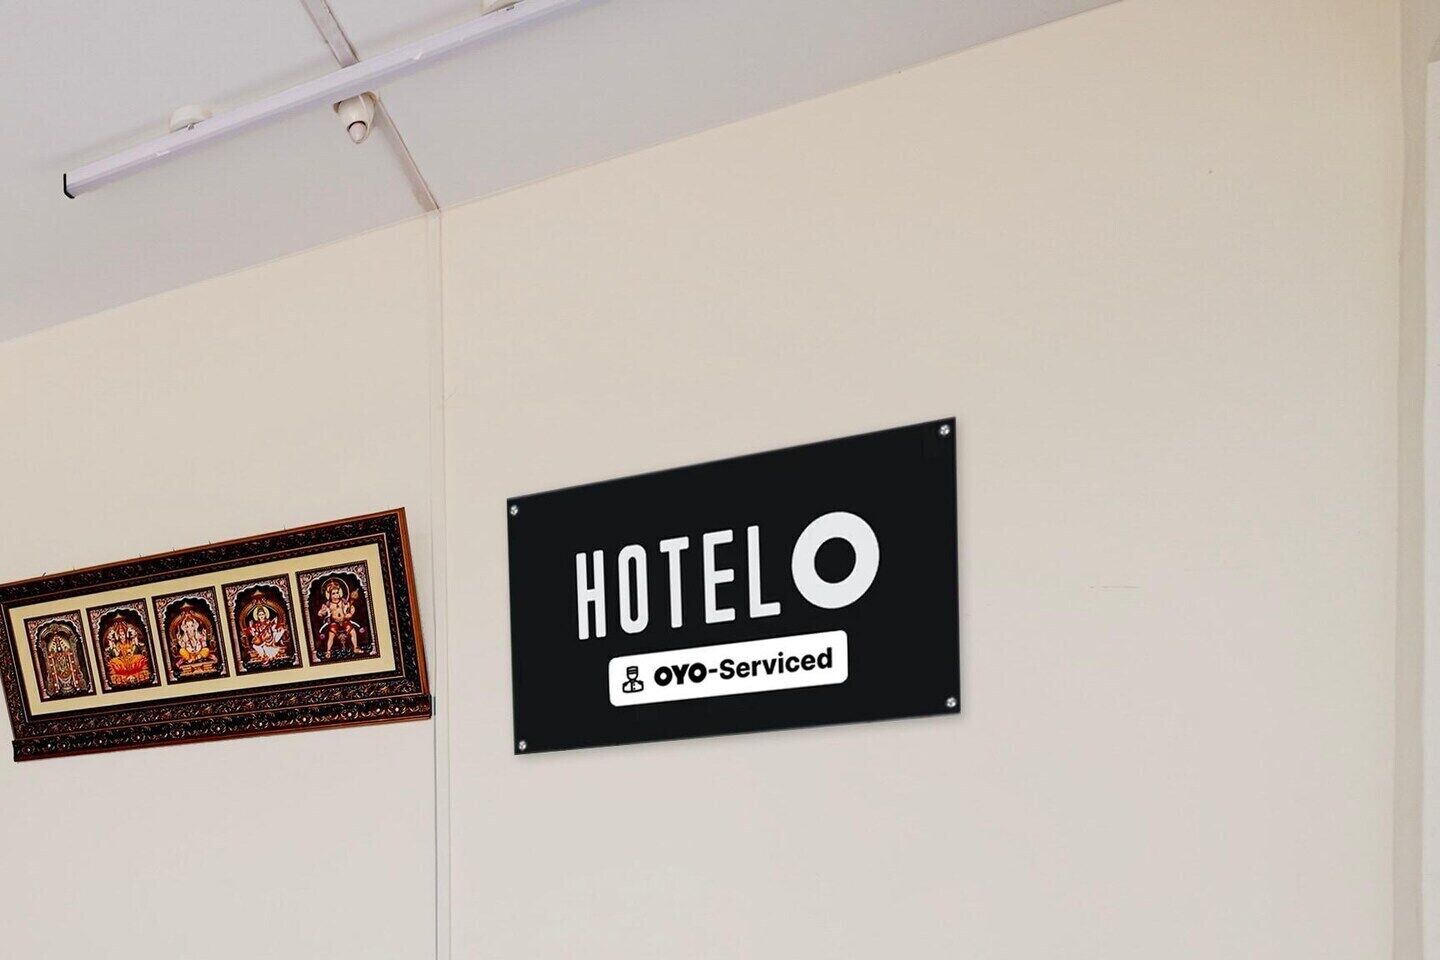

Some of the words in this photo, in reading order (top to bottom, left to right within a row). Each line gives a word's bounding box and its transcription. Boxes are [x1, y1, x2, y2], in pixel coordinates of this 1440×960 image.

[575, 525, 781, 640] HOTEL
[791, 511, 880, 609] O
[653, 646, 833, 687] OYO-Serviced
